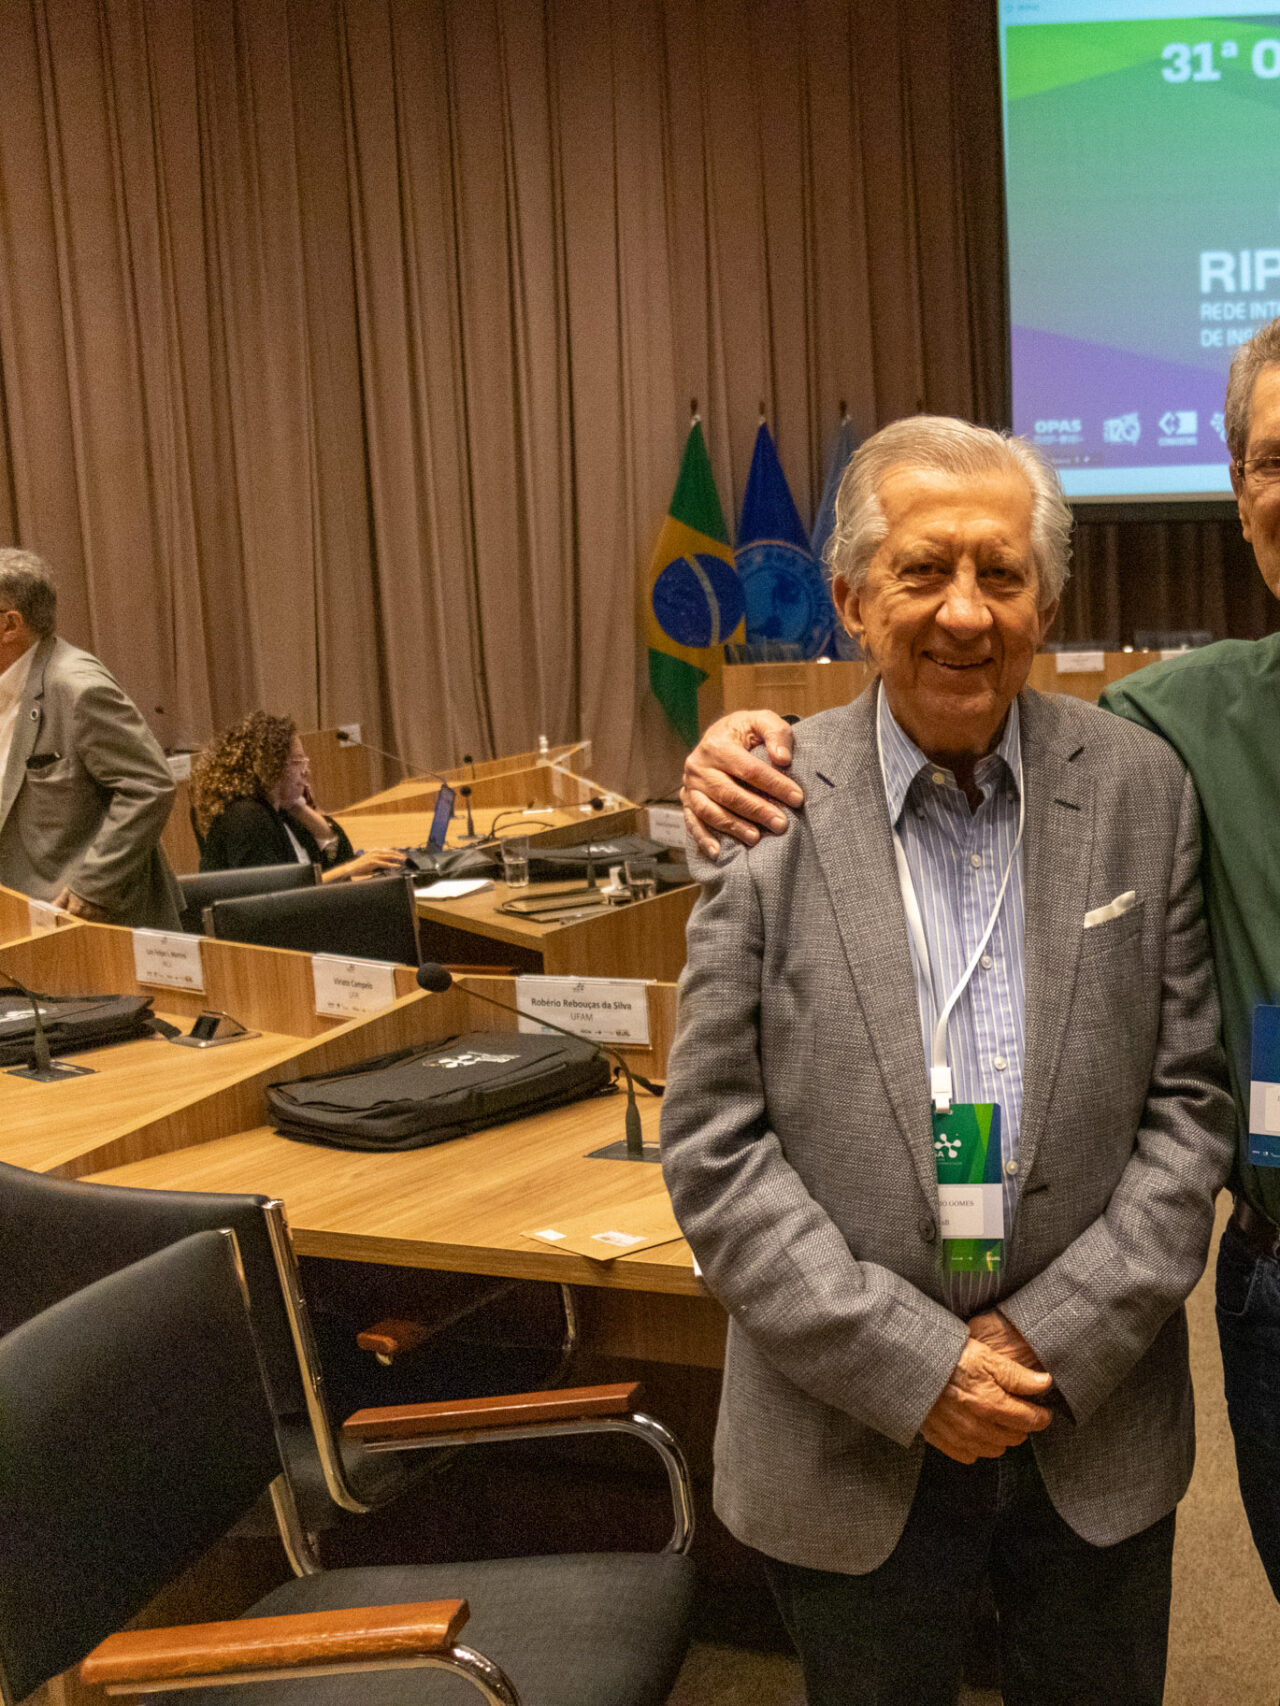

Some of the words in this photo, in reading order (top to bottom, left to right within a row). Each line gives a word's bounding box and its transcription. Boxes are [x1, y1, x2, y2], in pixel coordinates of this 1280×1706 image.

[1201, 301, 1246, 321] REDE
[1201, 328, 1223, 347] DE
[1034, 418, 1082, 434] OPAS
[531, 997, 561, 1008] Robério
[563, 999, 600, 1010] Rebouças
[601, 1001, 612, 1010] da
[613, 1001, 632, 1011] Silva
[570, 1012, 593, 1022] UFAM
